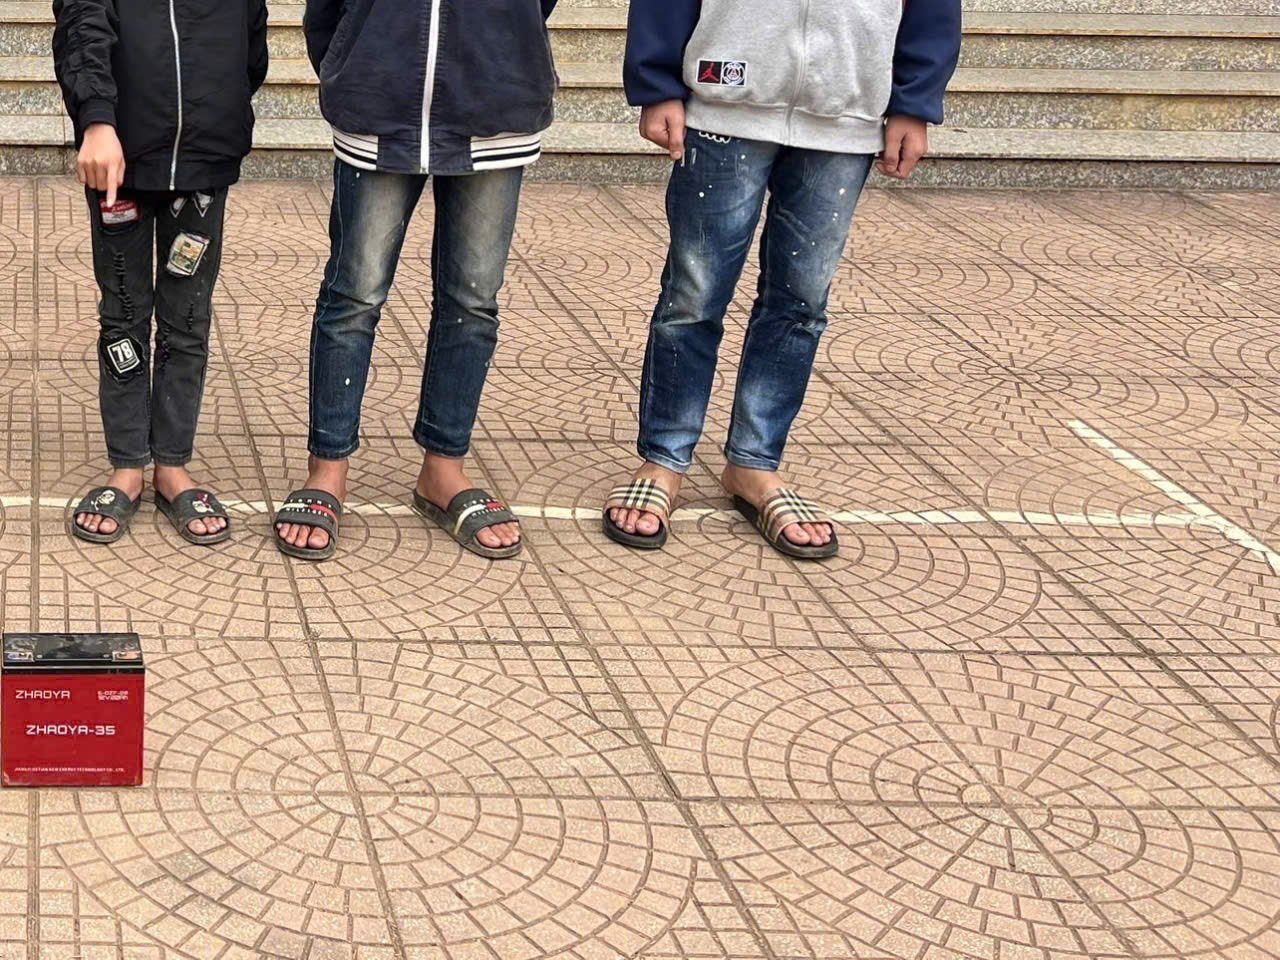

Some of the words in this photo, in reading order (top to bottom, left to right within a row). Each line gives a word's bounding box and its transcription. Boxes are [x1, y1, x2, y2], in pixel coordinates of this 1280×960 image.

[111, 341, 134, 363] 78
[15, 690, 70, 699] ZHAOYA
[26, 724, 116, 736] ZHAOYA-35
